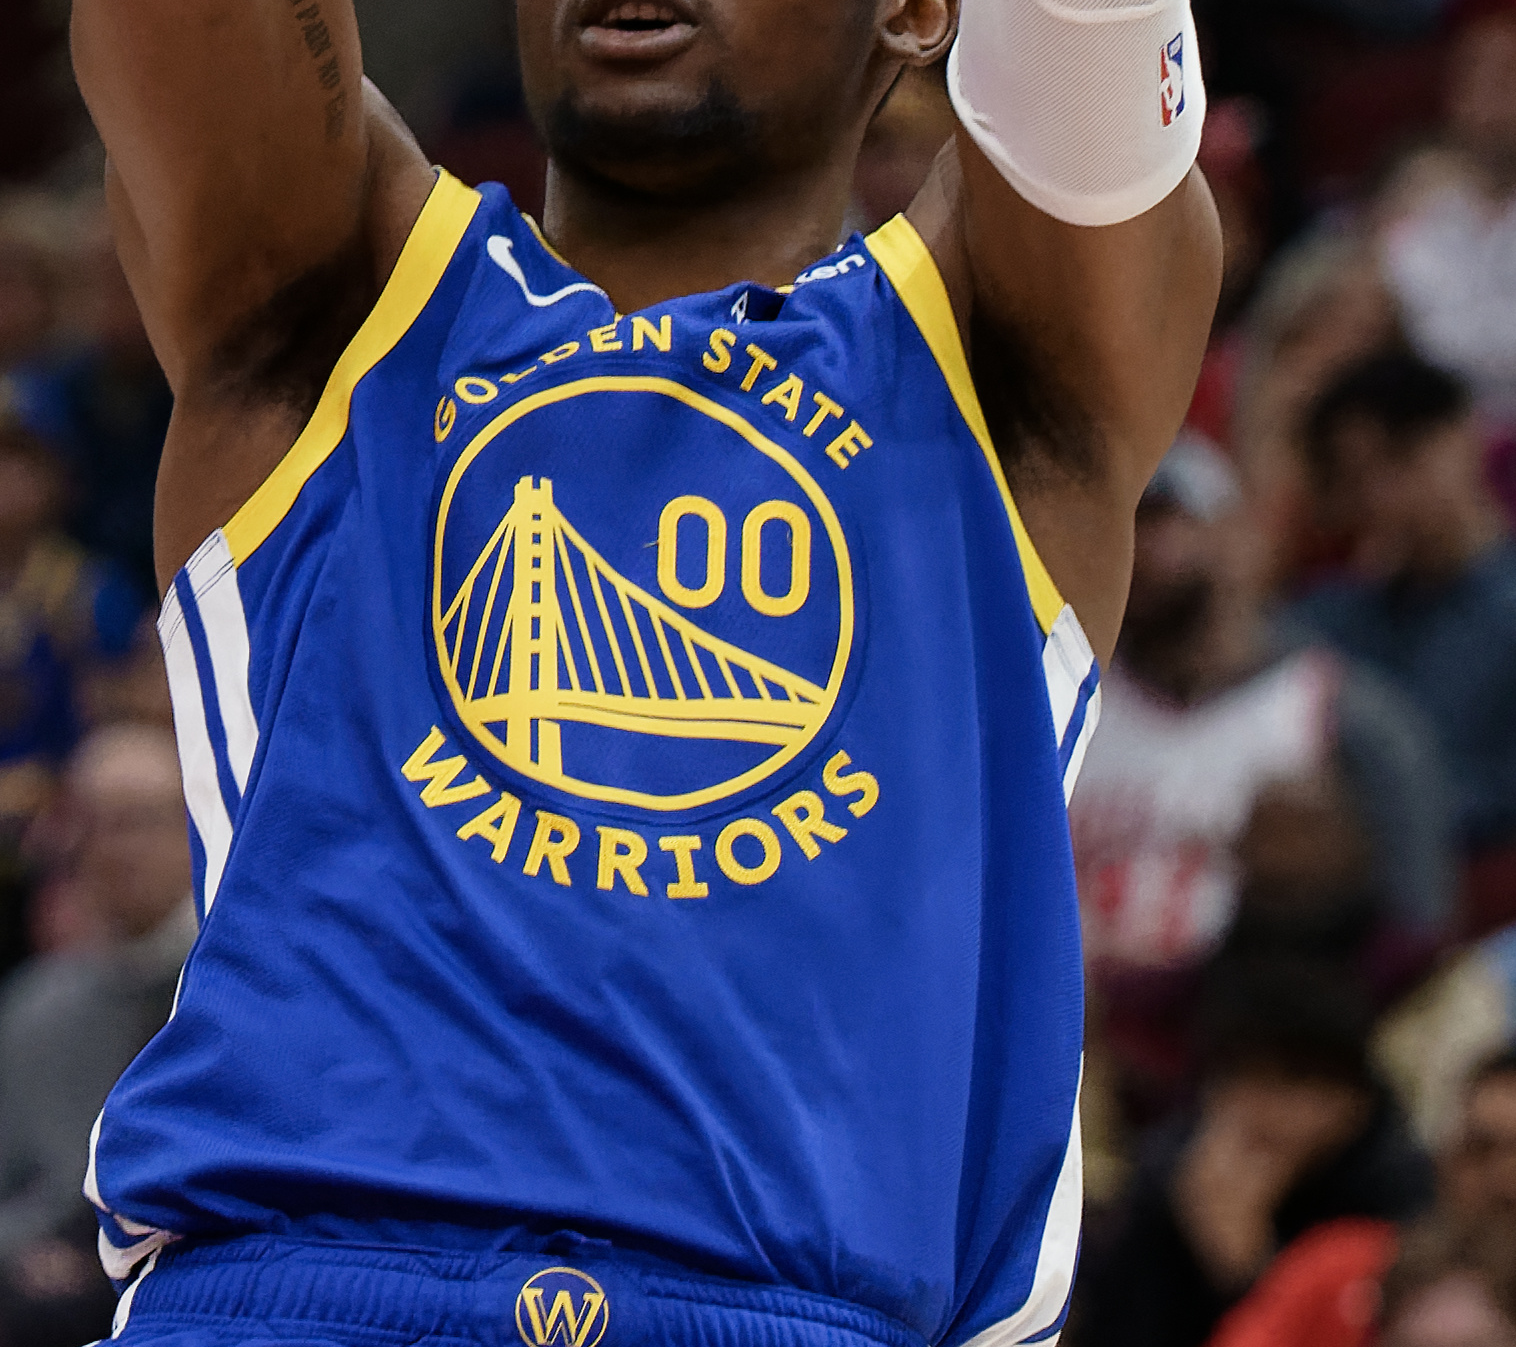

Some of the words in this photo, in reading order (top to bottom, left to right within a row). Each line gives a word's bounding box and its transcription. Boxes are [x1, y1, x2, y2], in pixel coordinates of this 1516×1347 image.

[434, 312, 674, 444] GOLDEN
[702, 327, 872, 471] STATE
[656, 494, 812, 617] 00
[400, 724, 881, 901] WARRIORS
